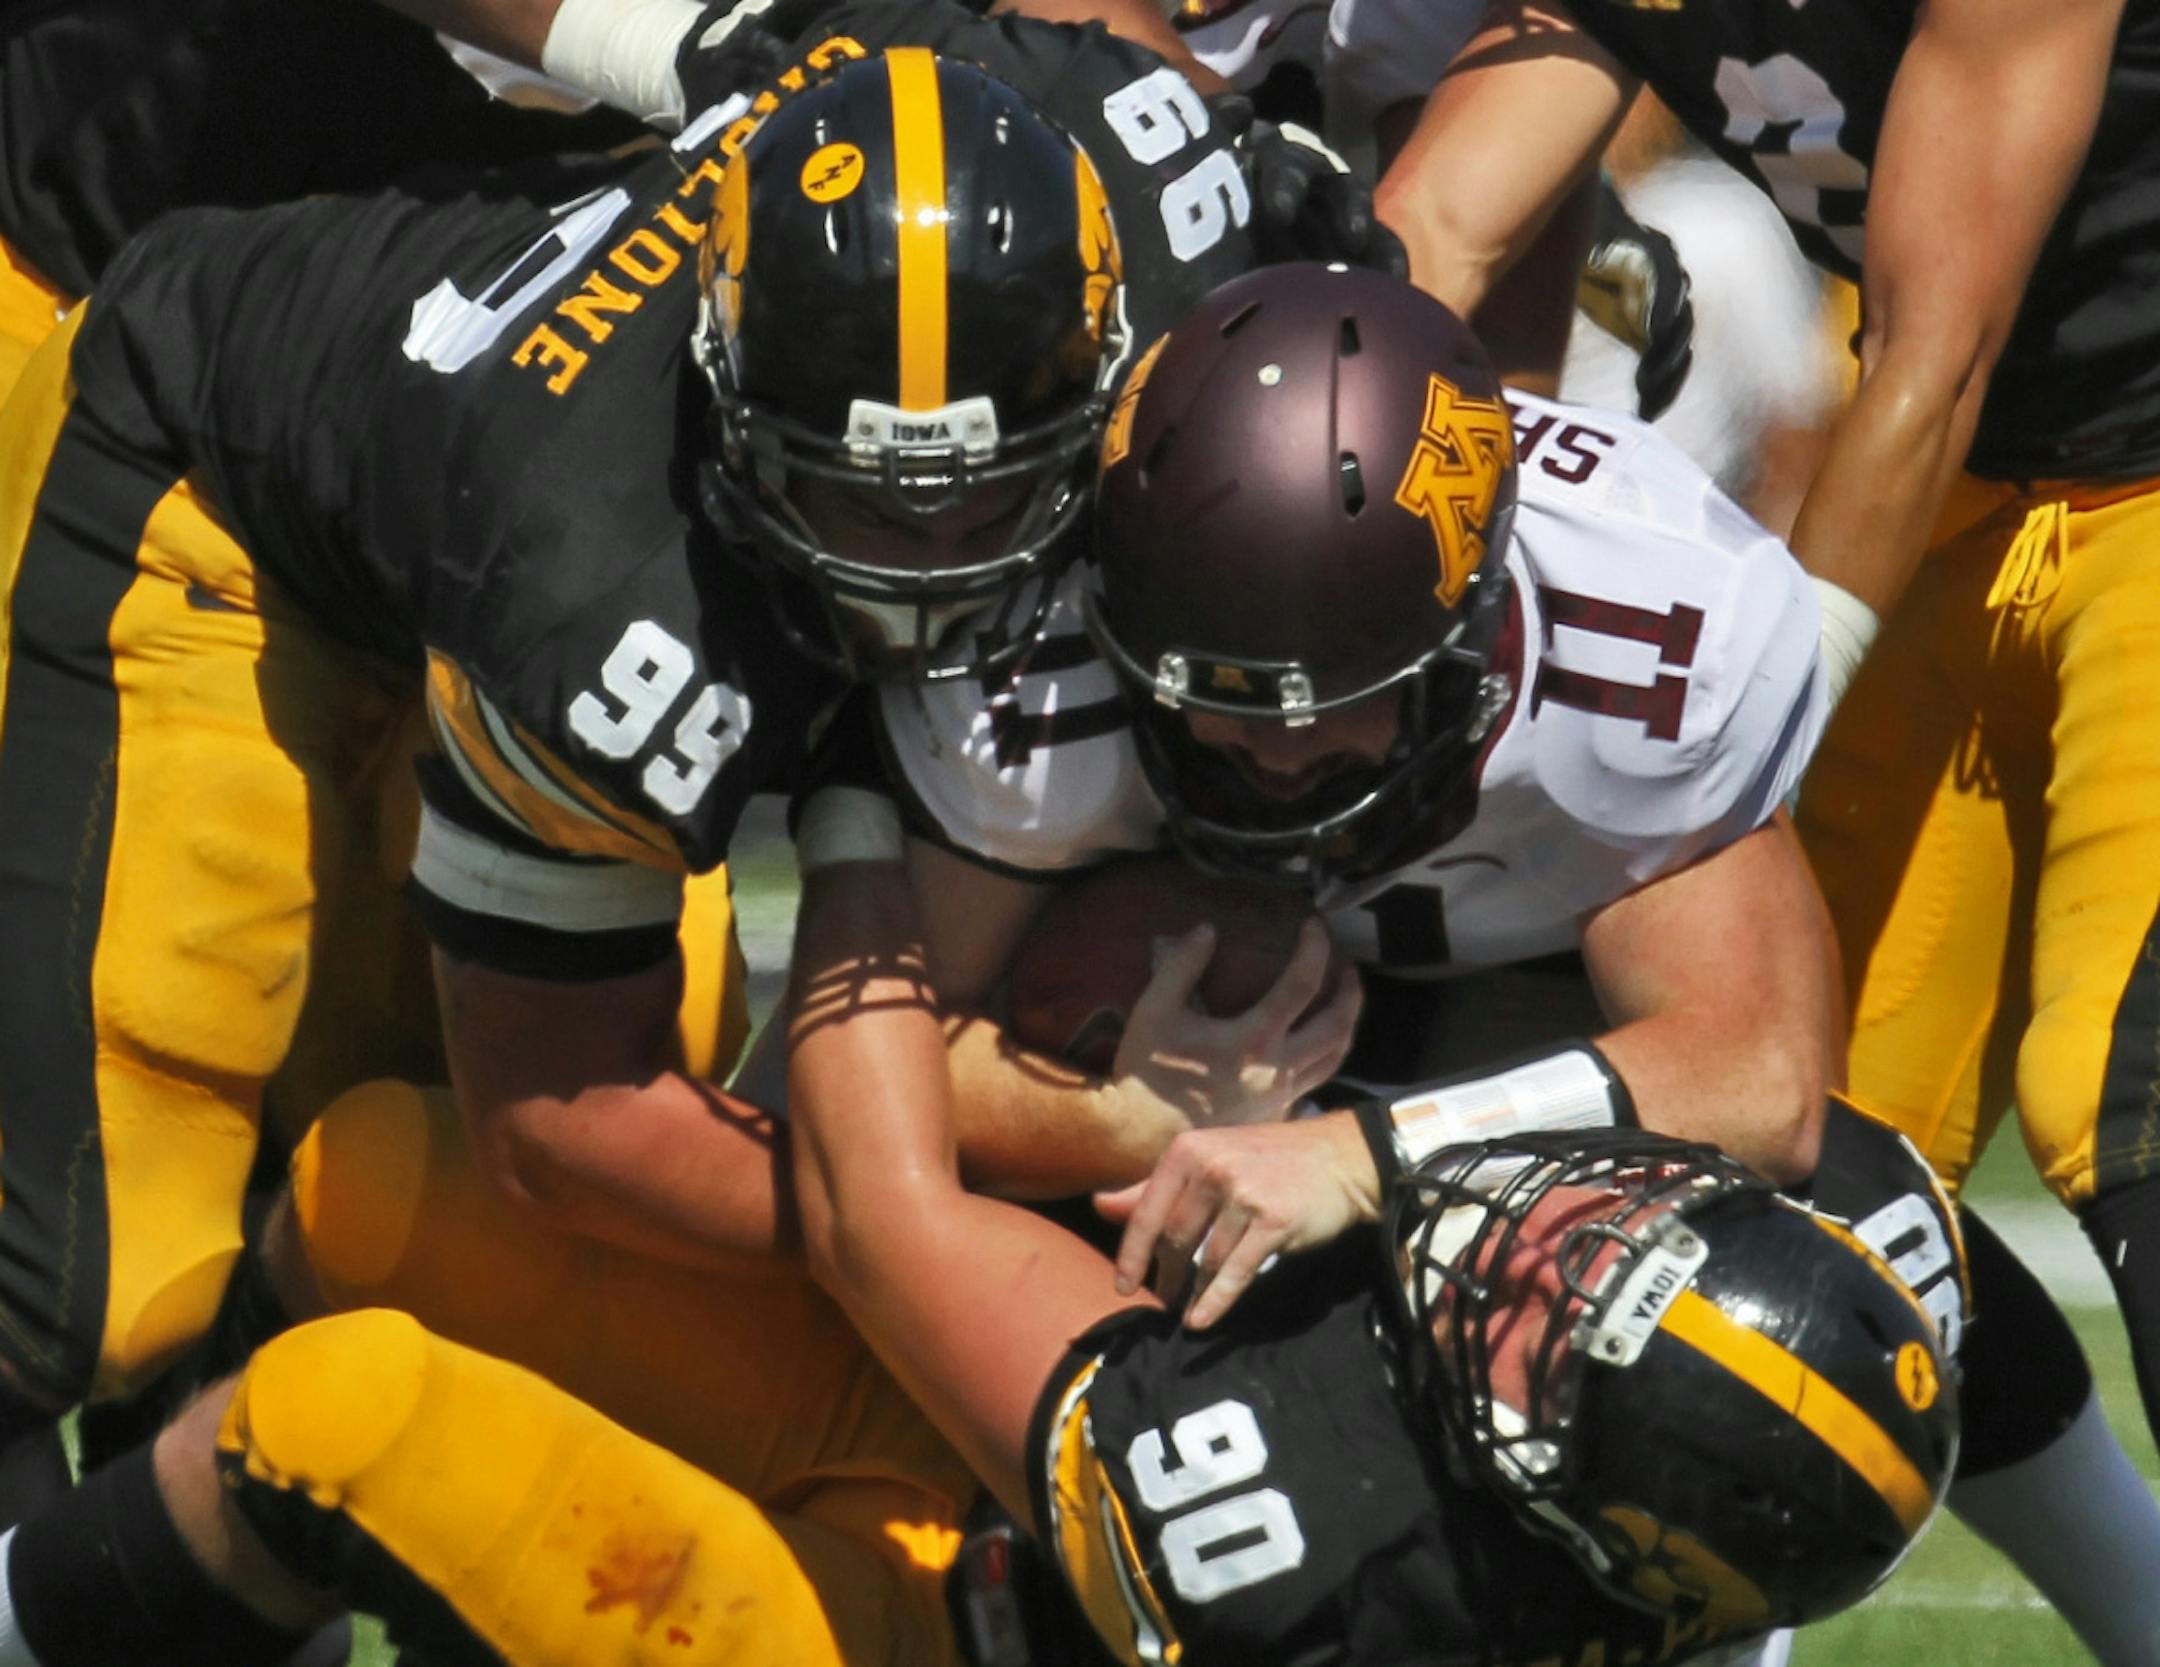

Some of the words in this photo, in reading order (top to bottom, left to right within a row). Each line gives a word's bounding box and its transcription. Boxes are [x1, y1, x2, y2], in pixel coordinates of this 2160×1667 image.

[892, 422, 951, 441] IOWA
[567, 618, 753, 816] 99
[1531, 583, 1705, 742] 11
[1632, 1266, 1681, 1319] IOWA
[1126, 1398, 1306, 1605] 90
